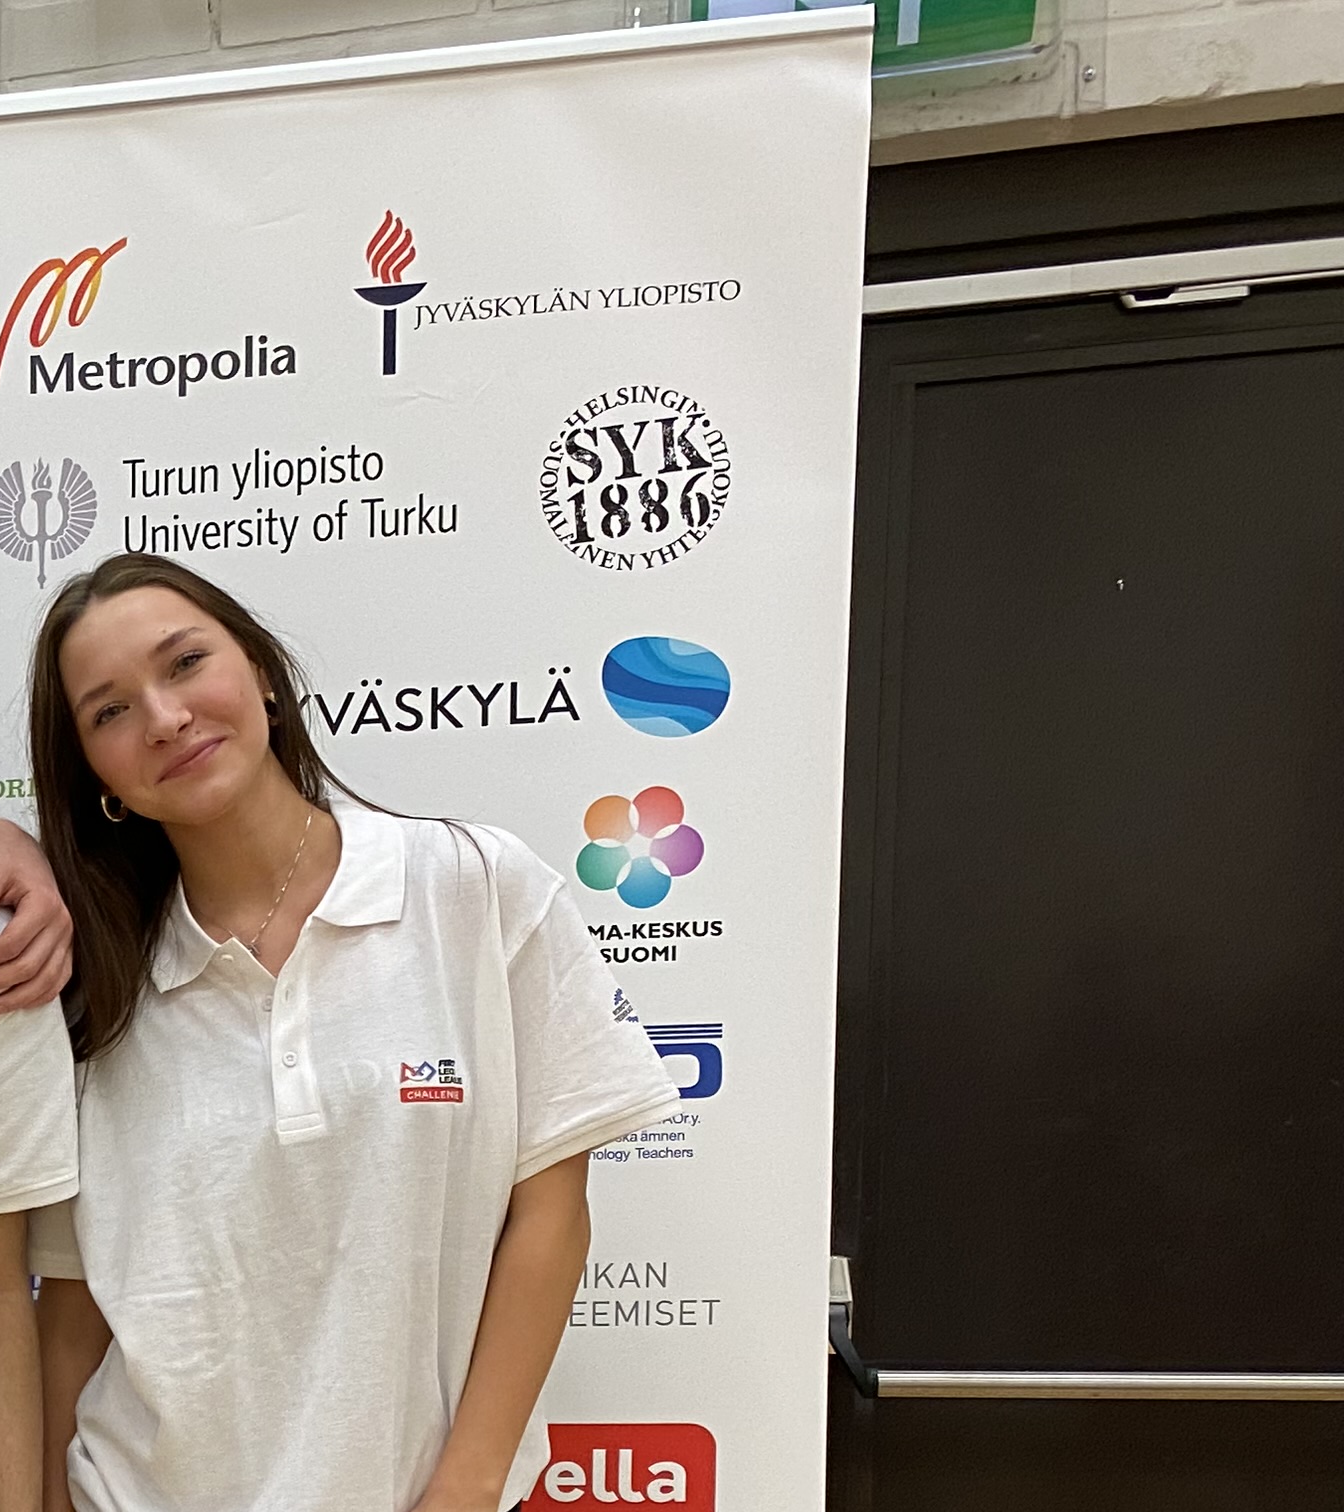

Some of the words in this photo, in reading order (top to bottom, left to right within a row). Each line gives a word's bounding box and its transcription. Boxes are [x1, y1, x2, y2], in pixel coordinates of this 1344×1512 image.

[414, 287, 591, 330] JYVÄSKYLÄN
[598, 279, 741, 309] YLIOPISTO
[29, 335, 296, 397] Metropolia
[123, 458, 219, 499] Turun
[232, 444, 384, 500] yliopisto
[565, 412, 713, 488] SYK
[124, 507, 299, 554] University
[313, 499, 348, 542] of
[361, 493, 458, 538] Turku
[567, 471, 711, 545] 1886
[600, 945, 677, 964] SUOMI
[635, 1147, 694, 1160] Teachers
[522, 1448, 687, 1504] ella
